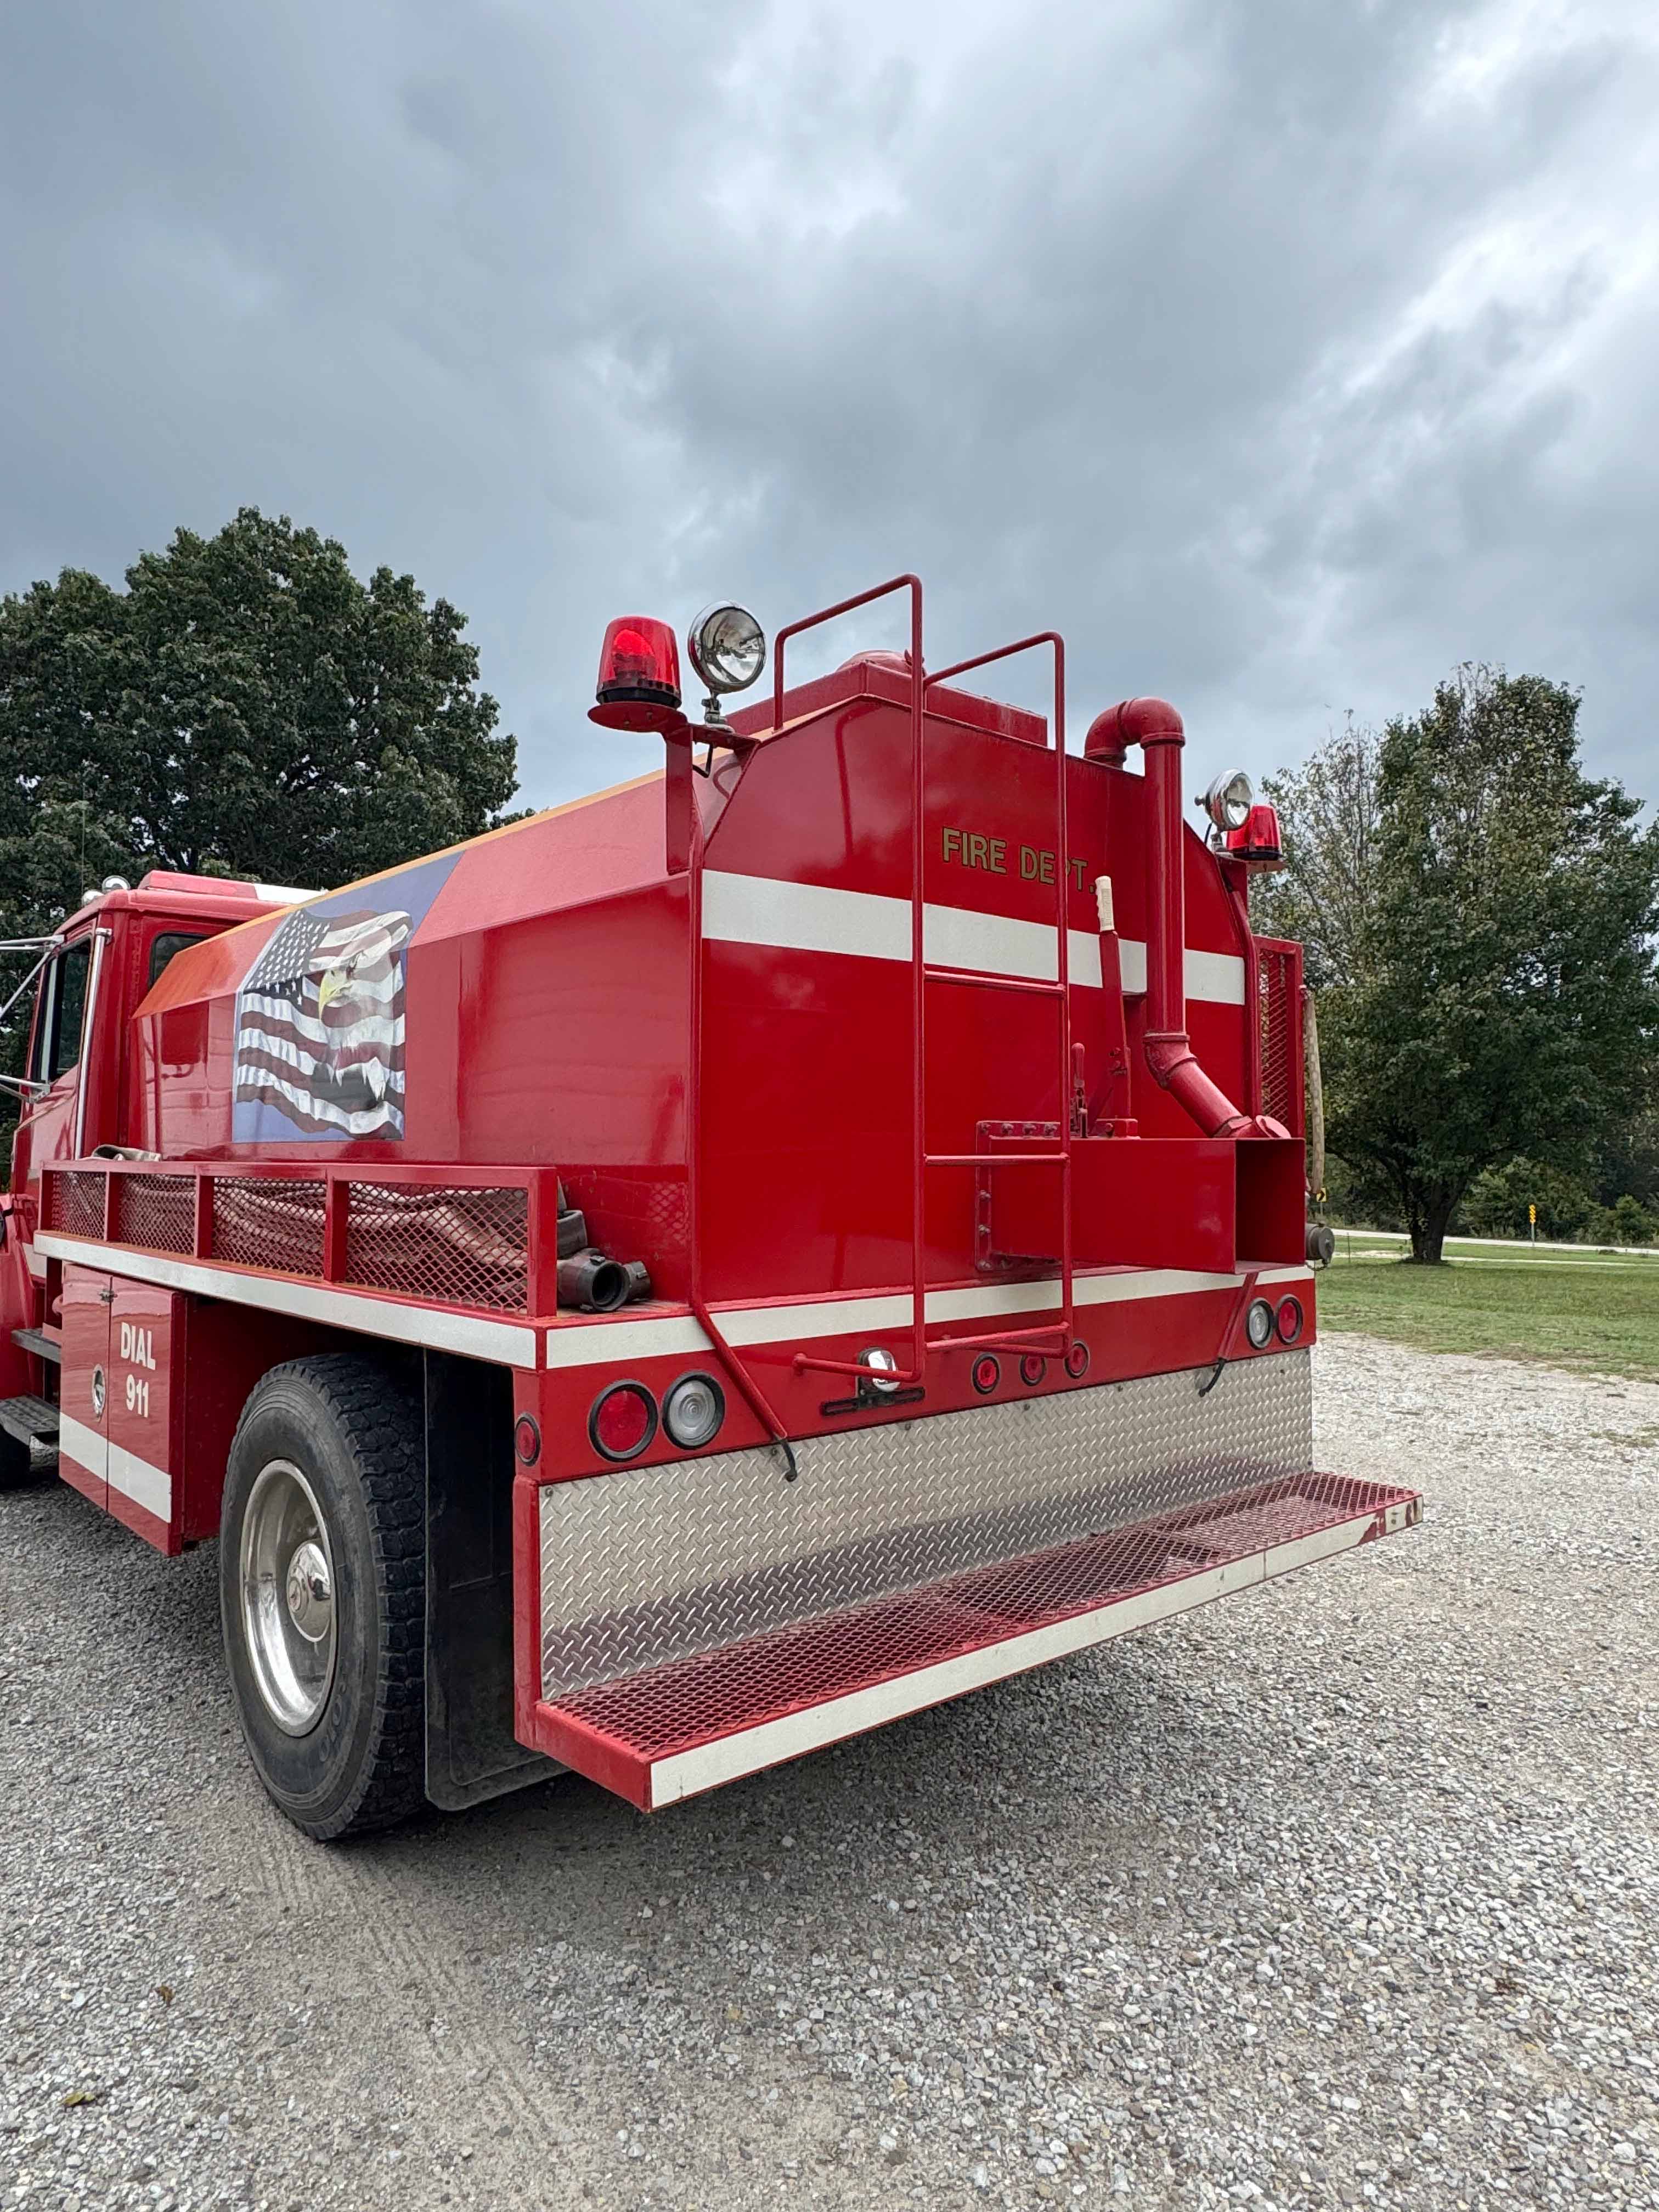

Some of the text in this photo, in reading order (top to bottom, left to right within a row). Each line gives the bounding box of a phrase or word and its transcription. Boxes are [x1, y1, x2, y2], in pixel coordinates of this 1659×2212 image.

[943, 826, 1094, 893] FIRE DET.
[121, 1322, 156, 1370] DIAL
[126, 1374, 149, 1418] 911
